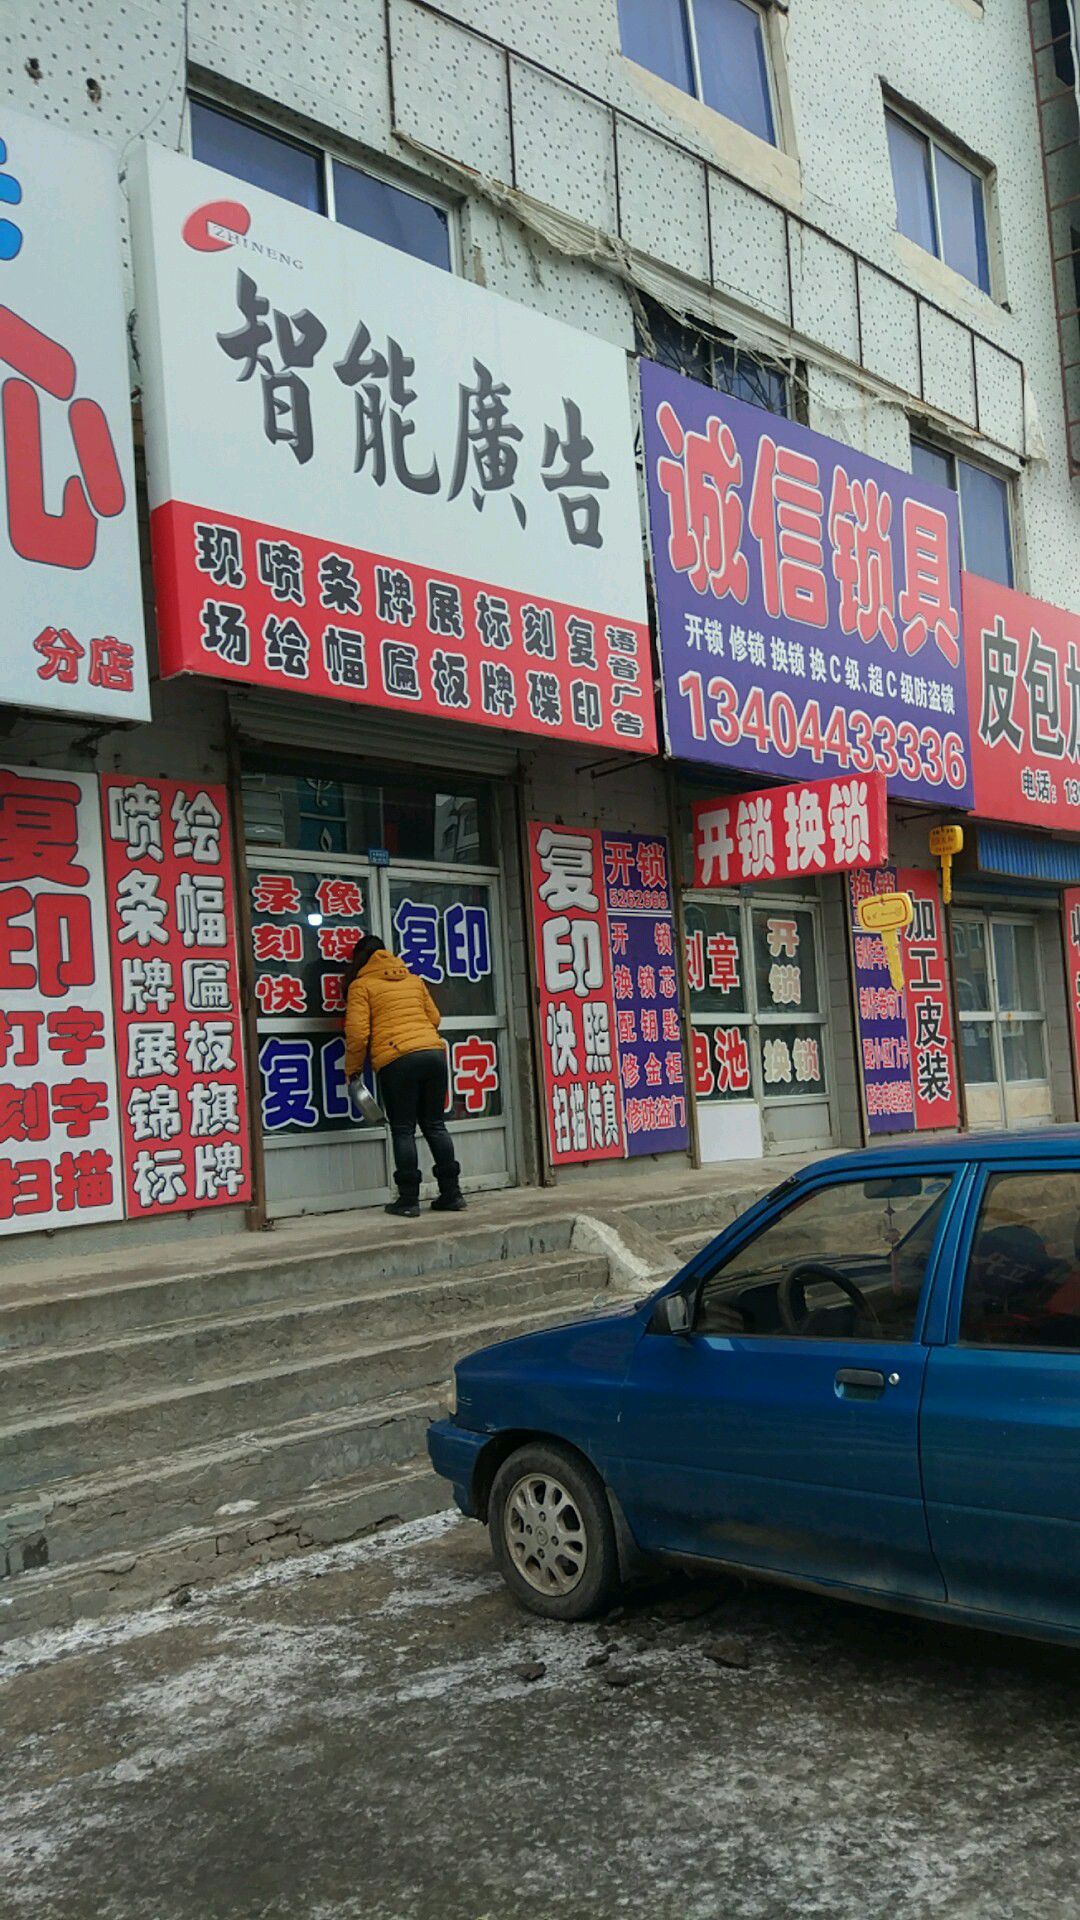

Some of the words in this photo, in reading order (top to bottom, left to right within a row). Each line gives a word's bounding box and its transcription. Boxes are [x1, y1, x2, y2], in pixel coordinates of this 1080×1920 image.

[212, 224, 304, 270] ZHINENG
[216, 266, 610, 549] 智能廣告
[656, 401, 960, 667] 诚信锁具
[194, 522, 250, 666] 现场
[256, 539, 310, 680] 喷绘
[319, 554, 368, 689] 条幅
[375, 565, 422, 700] 牌匾
[33, 626, 135, 692] 分店
[426, 579, 472, 709] 展板
[475, 591, 517, 718] 标牌
[521, 602, 562, 725] 刻碟
[566, 615, 602, 730] 复印
[605, 625, 644, 738] 语音广告
[684, 612, 724, 657] 开锁
[729, 624, 766, 668] 修锁
[770, 635, 806, 678] 换锁
[978, 614, 1080, 763] 皮包
[679, 670, 967, 790] 13404433336
[107, 782, 222, 864] 喷绘
[698, 796, 775, 886] 开锁
[784, 780, 871, 872] 换锁
[0, 769, 96, 998] 复印
[252, 874, 364, 917] 录像
[604, 841, 668, 889] 开锁
[115, 868, 228, 948] 条幅
[253, 923, 364, 963] 刻碟
[394, 898, 492, 985] 复印
[536, 828, 605, 998] 复印
[610, 922, 674, 957] 开锁
[120, 957, 233, 1014] 牌匾
[614, 964, 677, 1000] 换锁芯
[767, 919, 801, 1006] 开锁
[906, 891, 951, 1102] 加工皮装
[0, 1006, 105, 1067] 打字
[126, 1020, 238, 1078] 展板
[547, 1001, 613, 1077] 快照
[616, 1007, 681, 1043] 配钥匙
[763, 1037, 821, 1084] 换锁
[621, 1050, 684, 1089] 修金柜
[0, 1077, 109, 1142] 刻字
[128, 1081, 241, 1141] 锦旗
[552, 1079, 620, 1154] 扫描传真
[625, 1094, 687, 1135] 修防盗门
[0, 1148, 114, 1221] 扫描
[132, 1142, 246, 1208] 标牌
